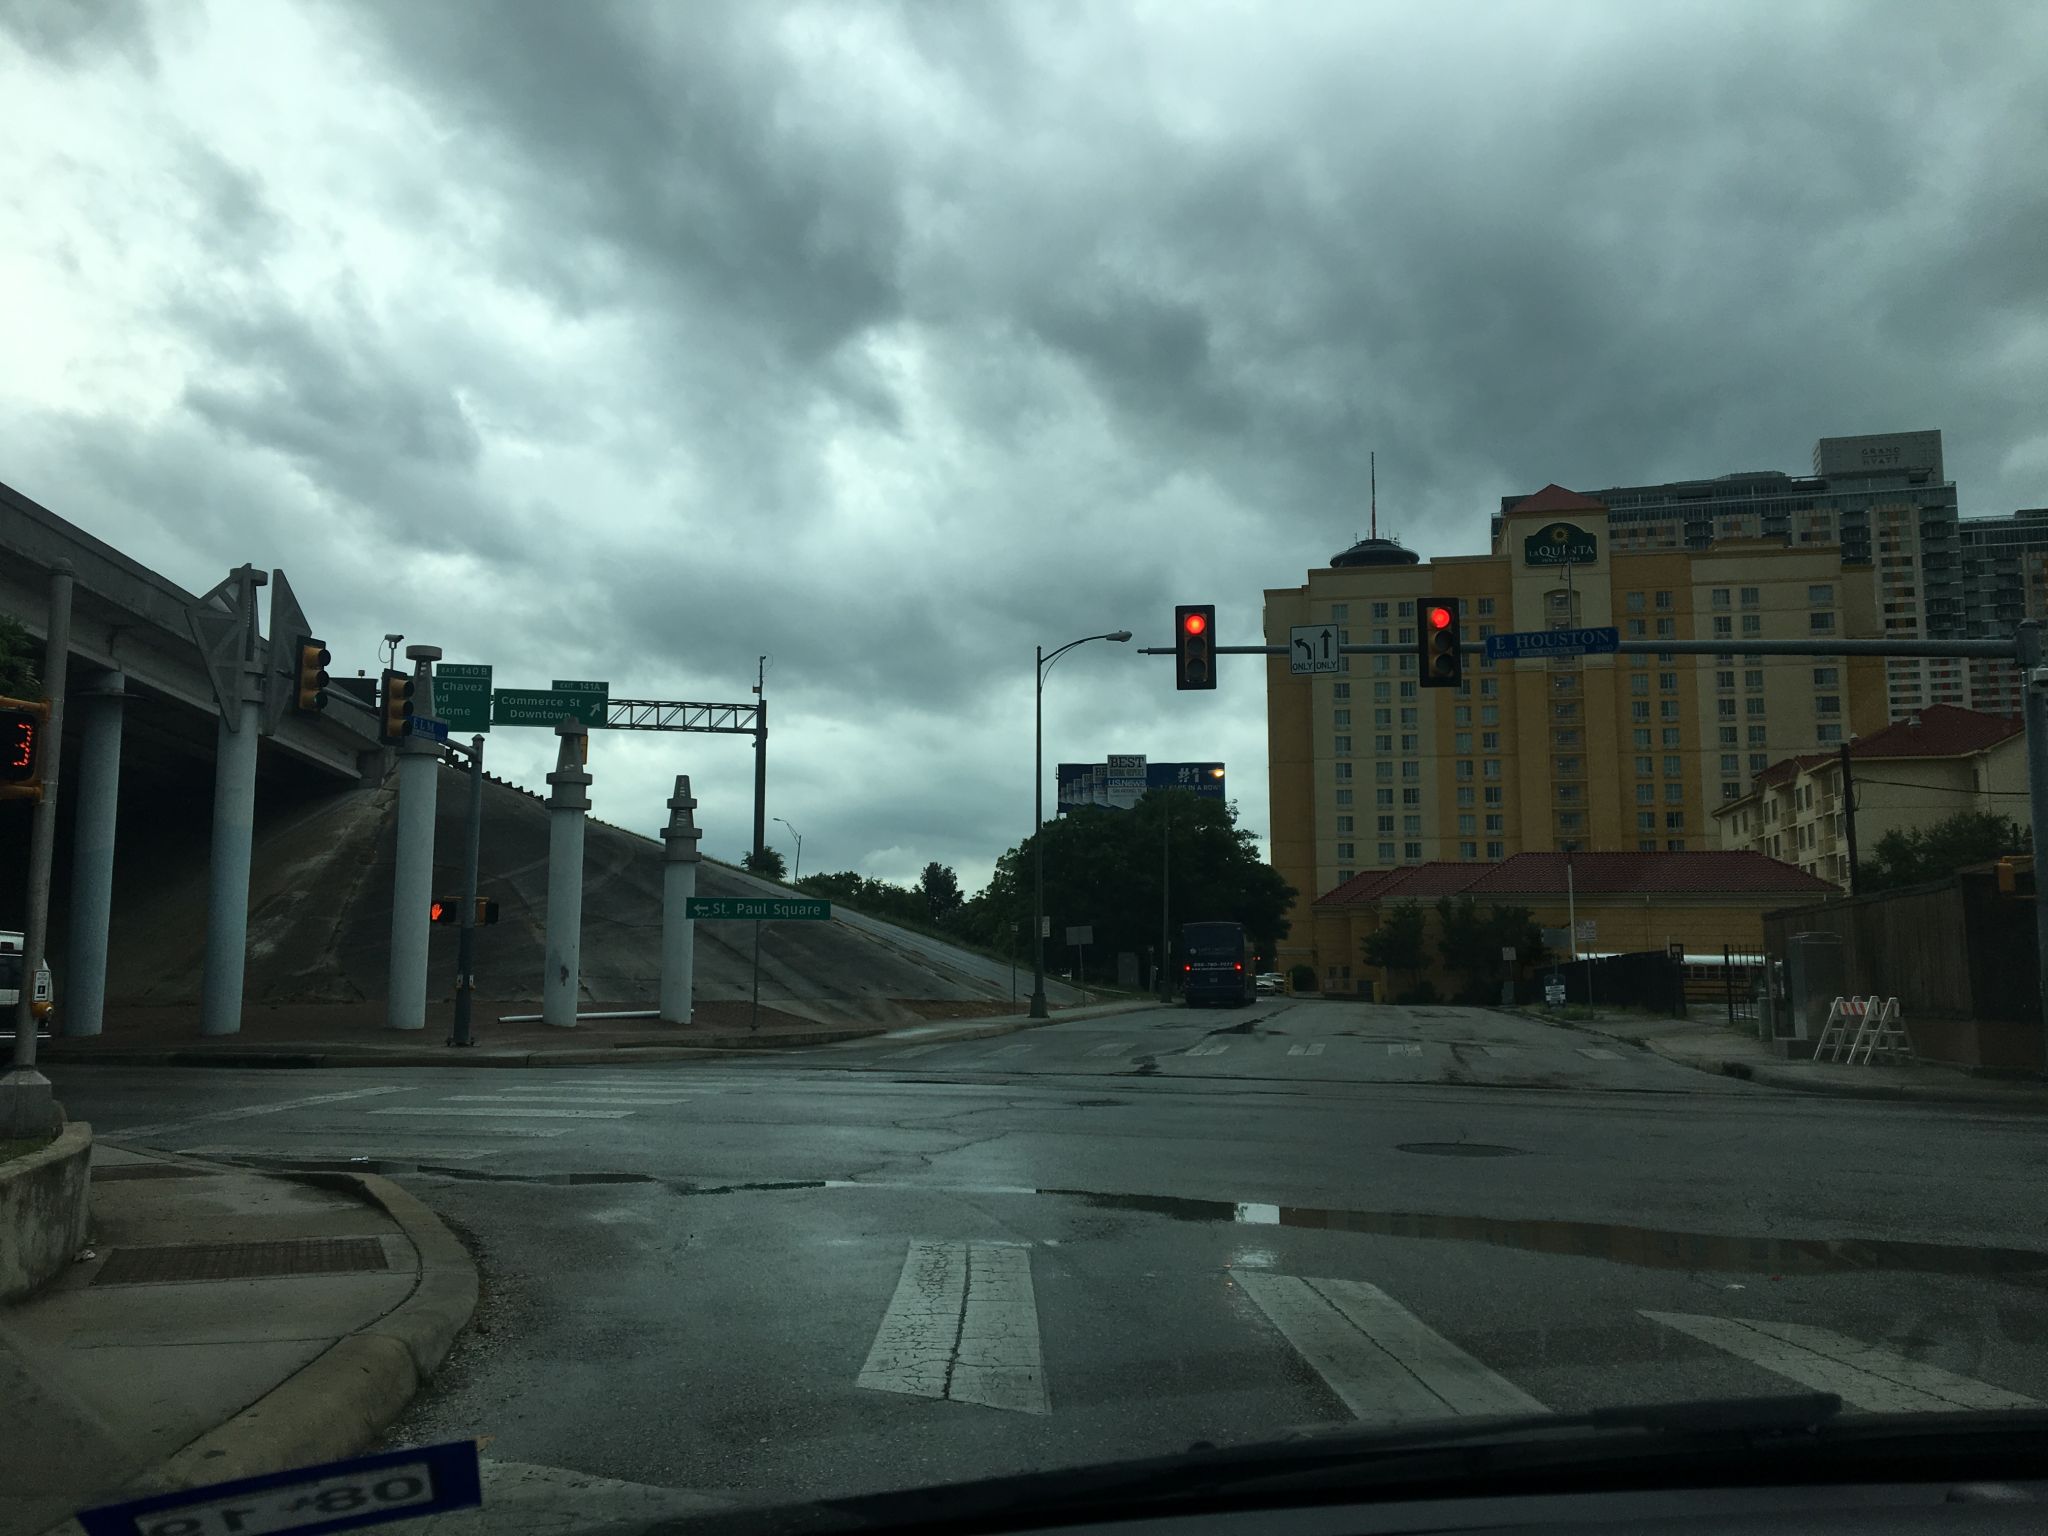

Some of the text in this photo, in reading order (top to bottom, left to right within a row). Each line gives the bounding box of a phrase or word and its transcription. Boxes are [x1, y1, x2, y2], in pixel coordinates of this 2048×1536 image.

[1862, 446, 1900, 455] GRAND
[1863, 456, 1898, 465] HYATT
[1496, 630, 1610, 650] E HOUSTON
[1292, 662, 1313, 671] ONLY
[1316, 660, 1337, 670] ONLY
[462, 667, 480, 676] 140
[442, 682, 484, 692] Chavez
[580, 682, 601, 691] 141A
[501, 696, 580, 708] Commerce St
[510, 709, 571, 720] Downtown
[413, 717, 436, 733] ELM
[1110, 756, 1145, 768] BEST
[1177, 767, 1200, 783] #1
[713, 902, 822, 918] St. Paul Square
